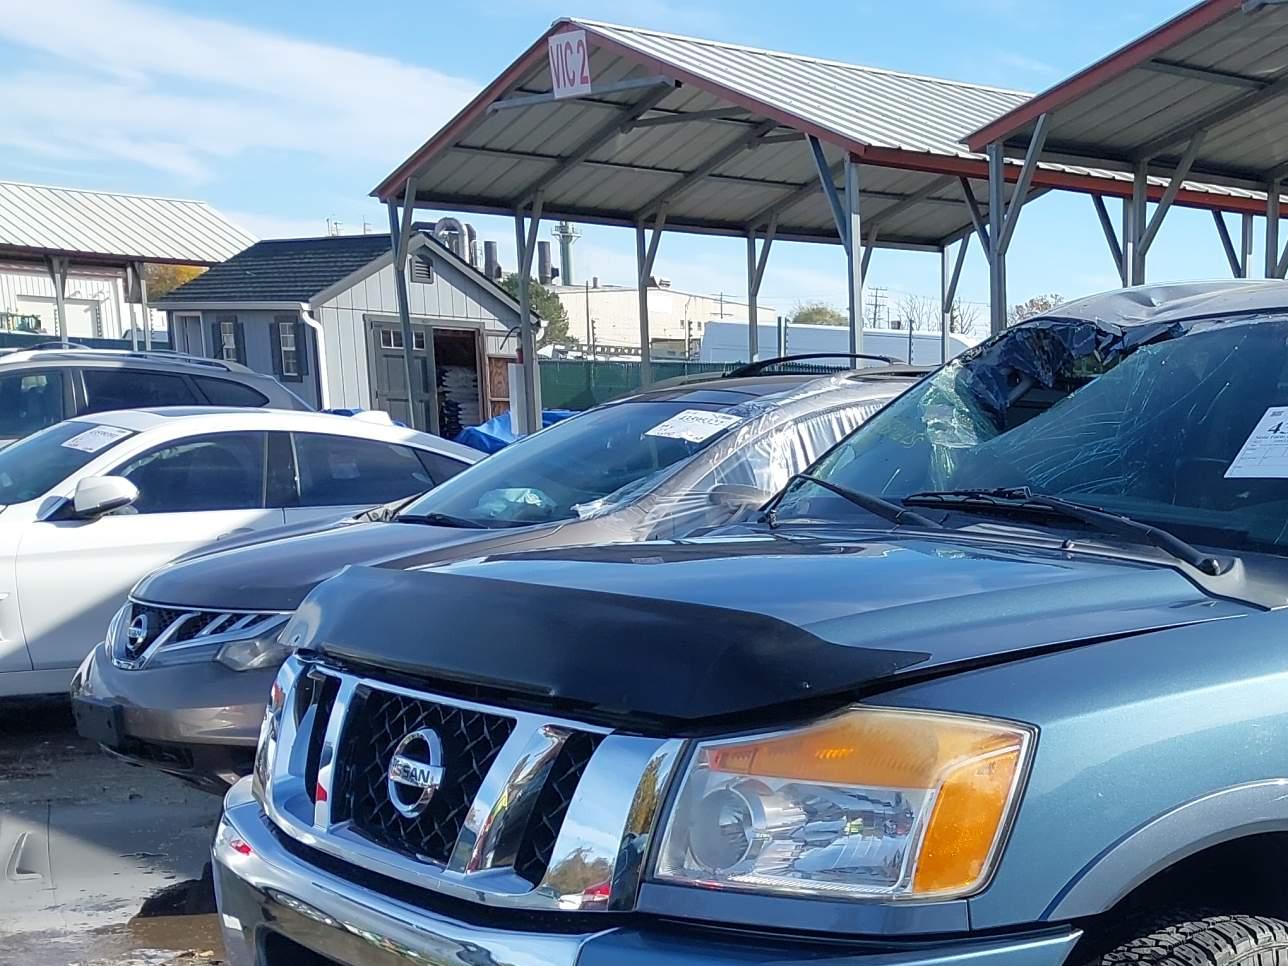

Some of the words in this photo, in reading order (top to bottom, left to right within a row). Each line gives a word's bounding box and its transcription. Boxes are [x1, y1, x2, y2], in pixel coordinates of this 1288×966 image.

[550, 41, 575, 89] VIC
[577, 39, 589, 85] 2
[391, 757, 431, 784] NISSAN
